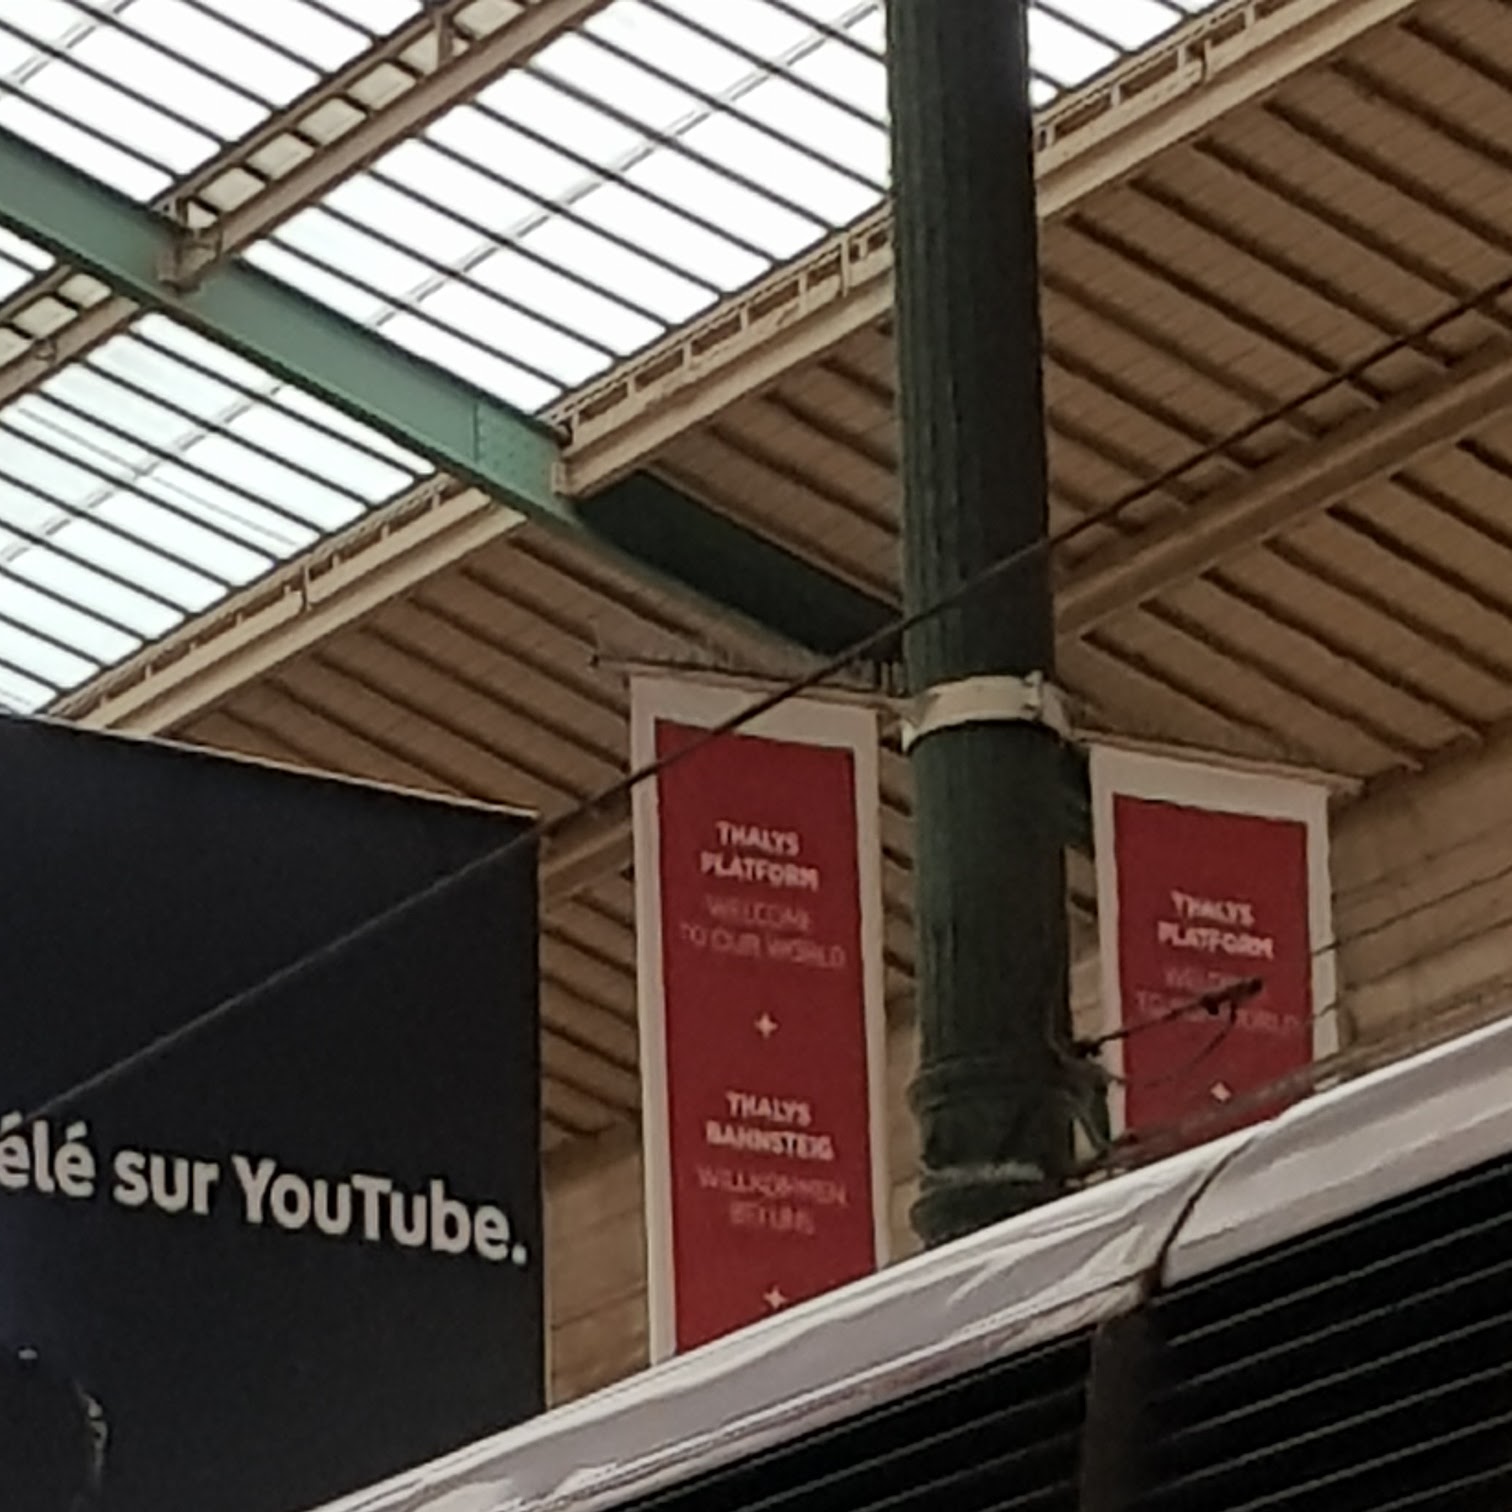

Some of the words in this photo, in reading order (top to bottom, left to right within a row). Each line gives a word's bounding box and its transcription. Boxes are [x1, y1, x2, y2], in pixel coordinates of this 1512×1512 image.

[700, 851, 821, 892] PLATFORM
[113, 1150, 219, 1215] sur
[232, 1153, 529, 1266] YouTube.
